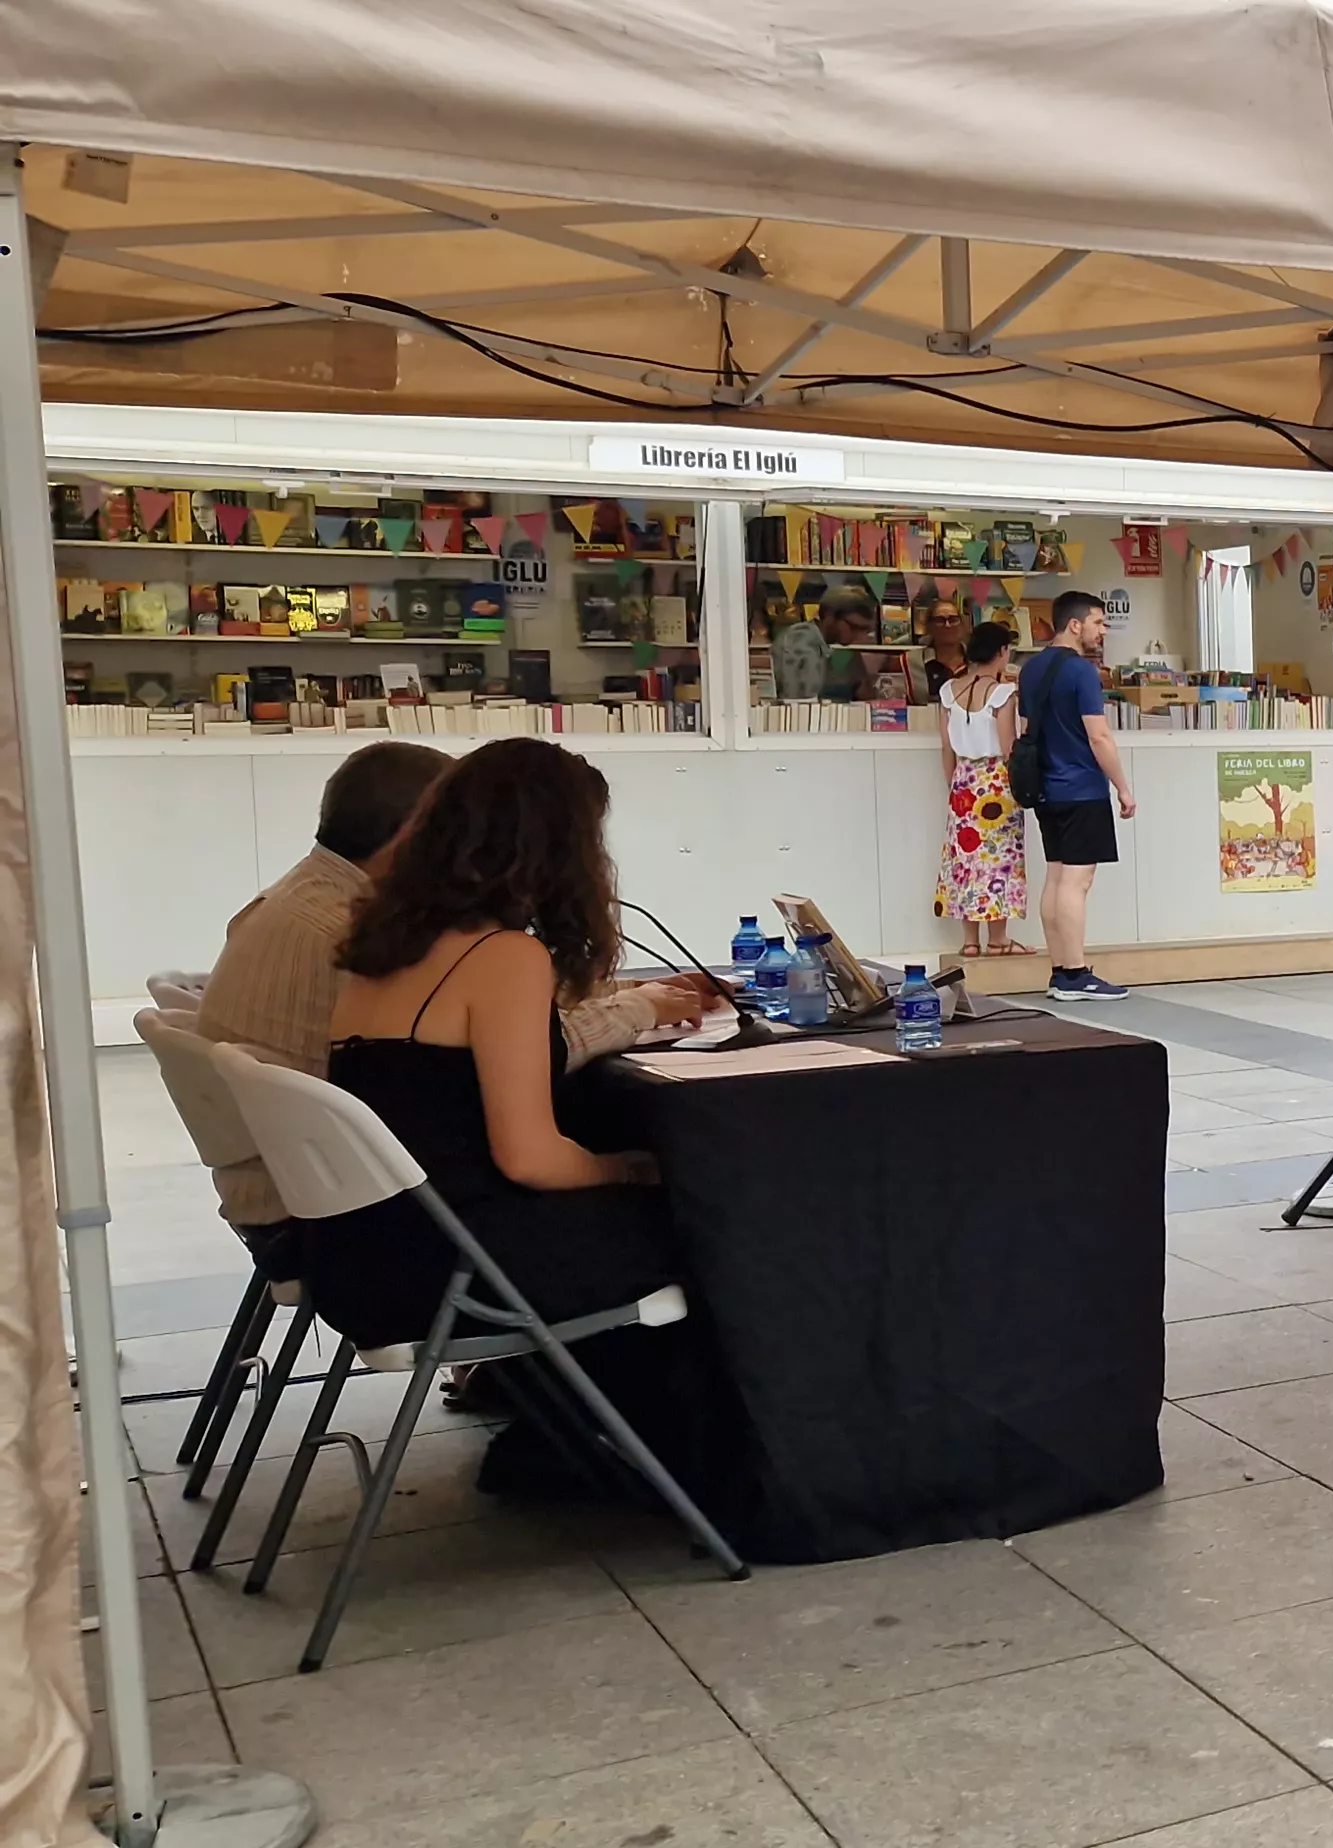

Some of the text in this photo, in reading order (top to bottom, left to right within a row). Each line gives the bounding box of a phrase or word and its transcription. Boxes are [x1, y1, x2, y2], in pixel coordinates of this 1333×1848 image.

[641, 444, 798, 475] Librería El Iglú
[1106, 600, 1130, 614] GLU
[1224, 758, 1306, 769] FERIA DEL LIBRO
